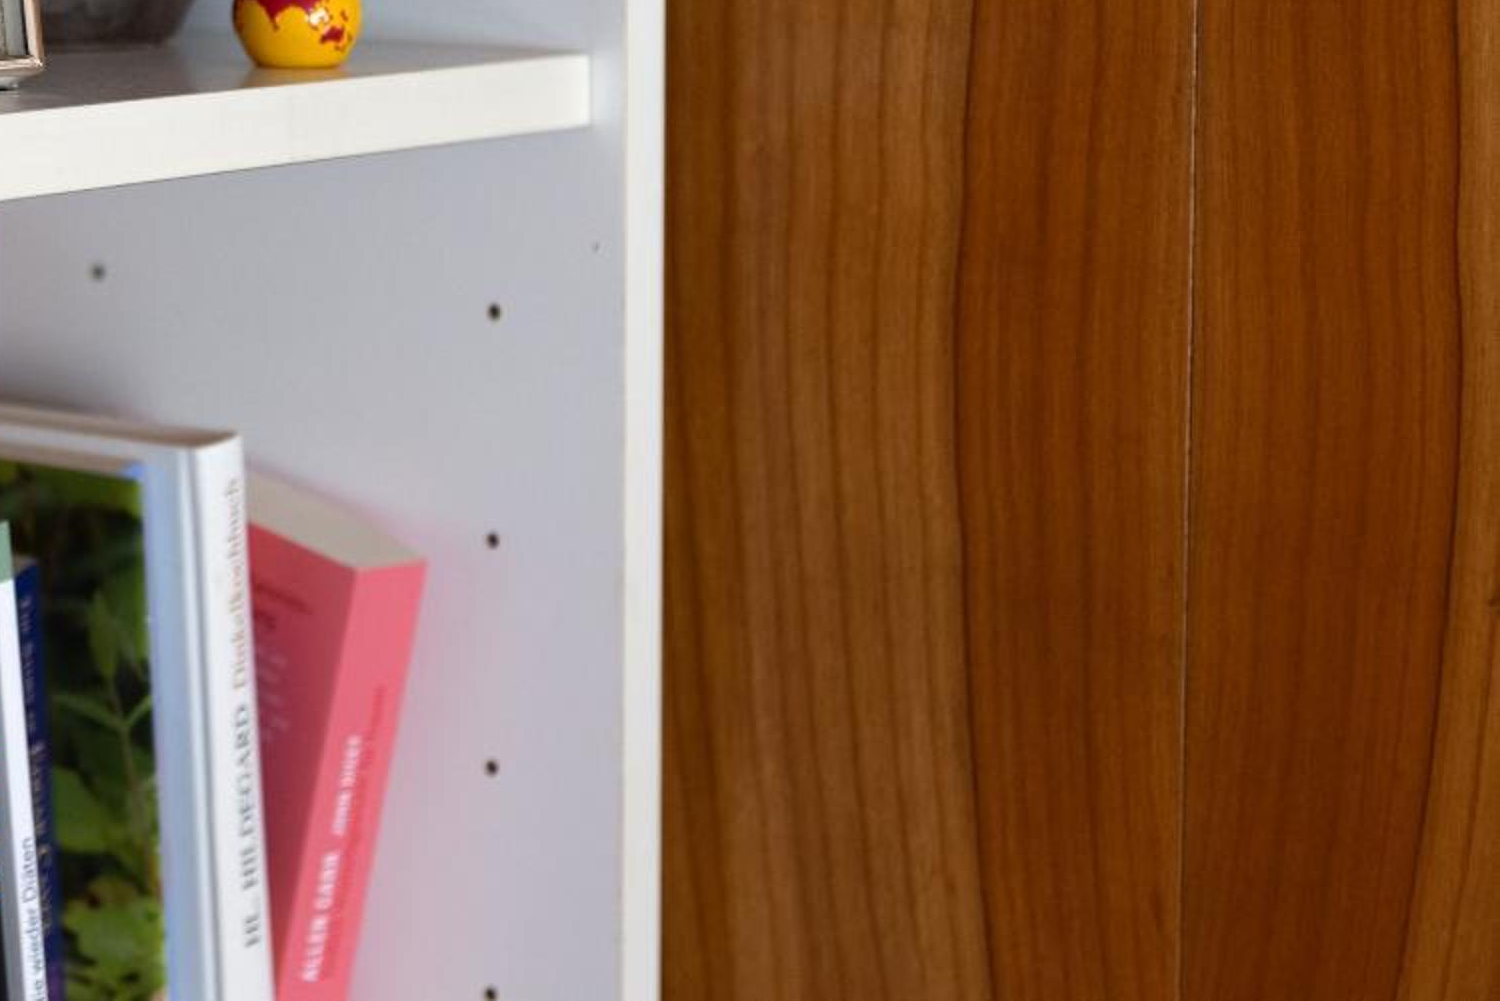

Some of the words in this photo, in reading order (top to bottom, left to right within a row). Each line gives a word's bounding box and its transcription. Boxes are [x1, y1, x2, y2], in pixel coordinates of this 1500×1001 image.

[234, 705, 258, 893] HILDEGARD
[18, 836, 38, 903] Diäten
[25, 907, 45, 975] wieder
